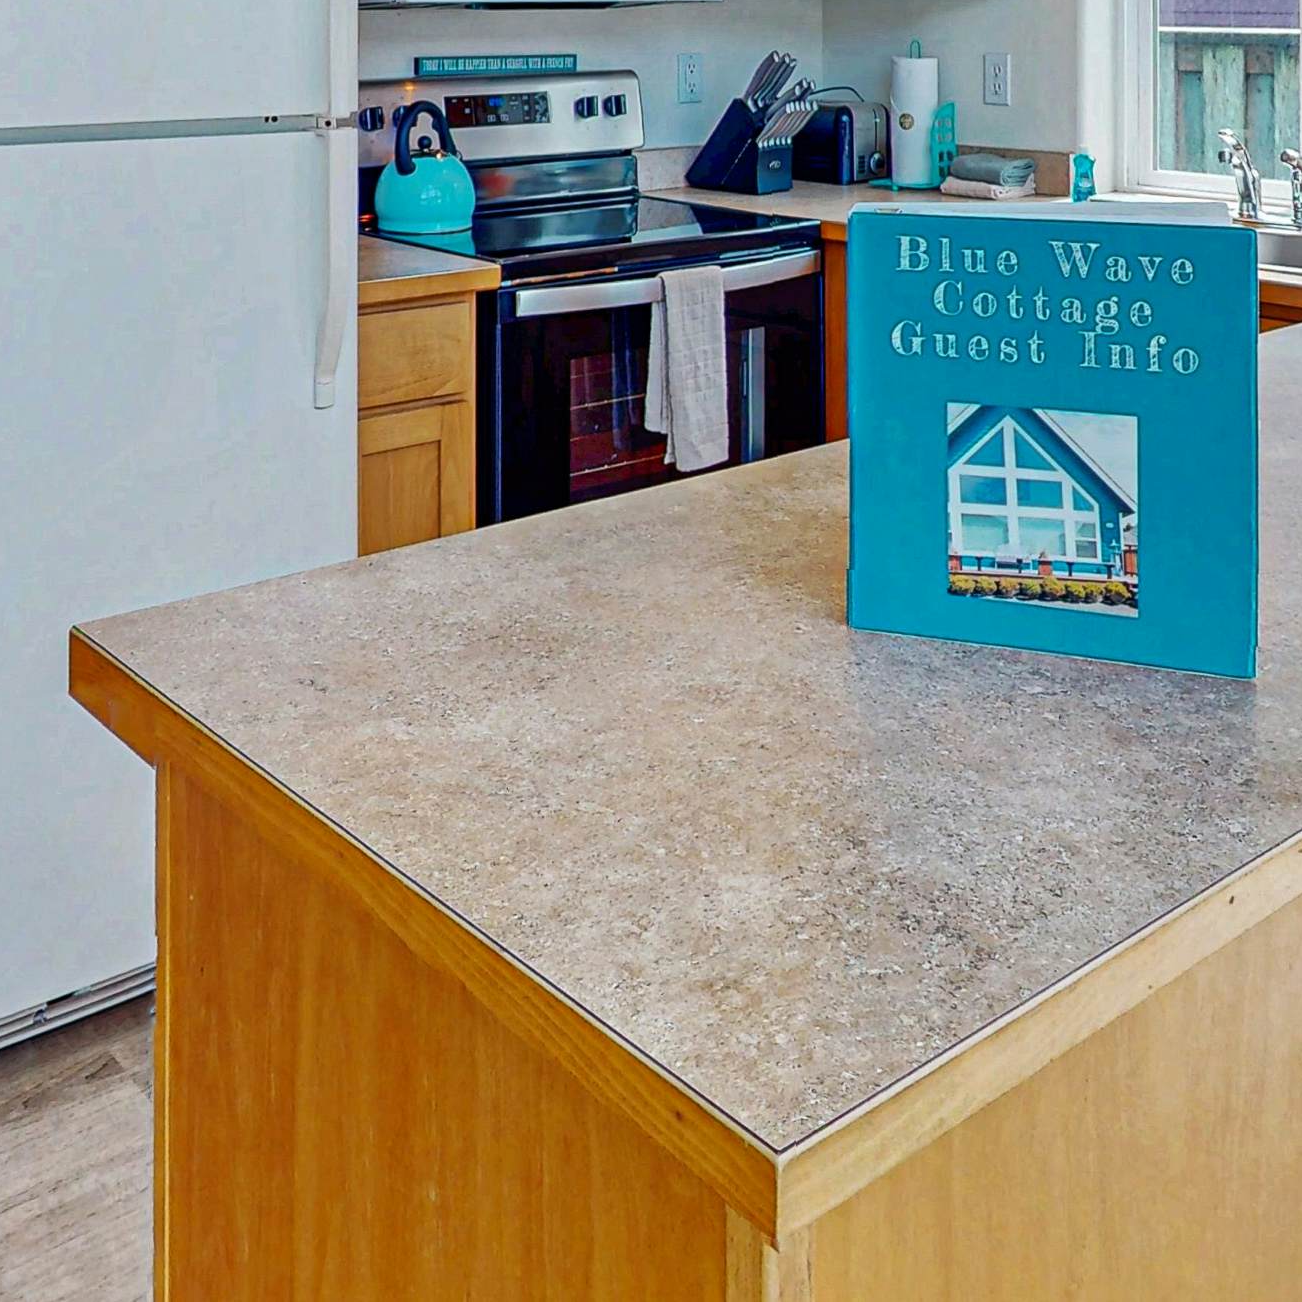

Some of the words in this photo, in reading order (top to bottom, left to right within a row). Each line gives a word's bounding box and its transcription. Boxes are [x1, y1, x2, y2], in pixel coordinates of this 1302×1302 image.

[895, 235, 1019, 276] Blue
[1049, 240, 1195, 285] Wave
[933, 280, 1153, 335] Cottage
[891, 320, 1046, 364] Guest
[1078, 330, 1199, 375] Info
